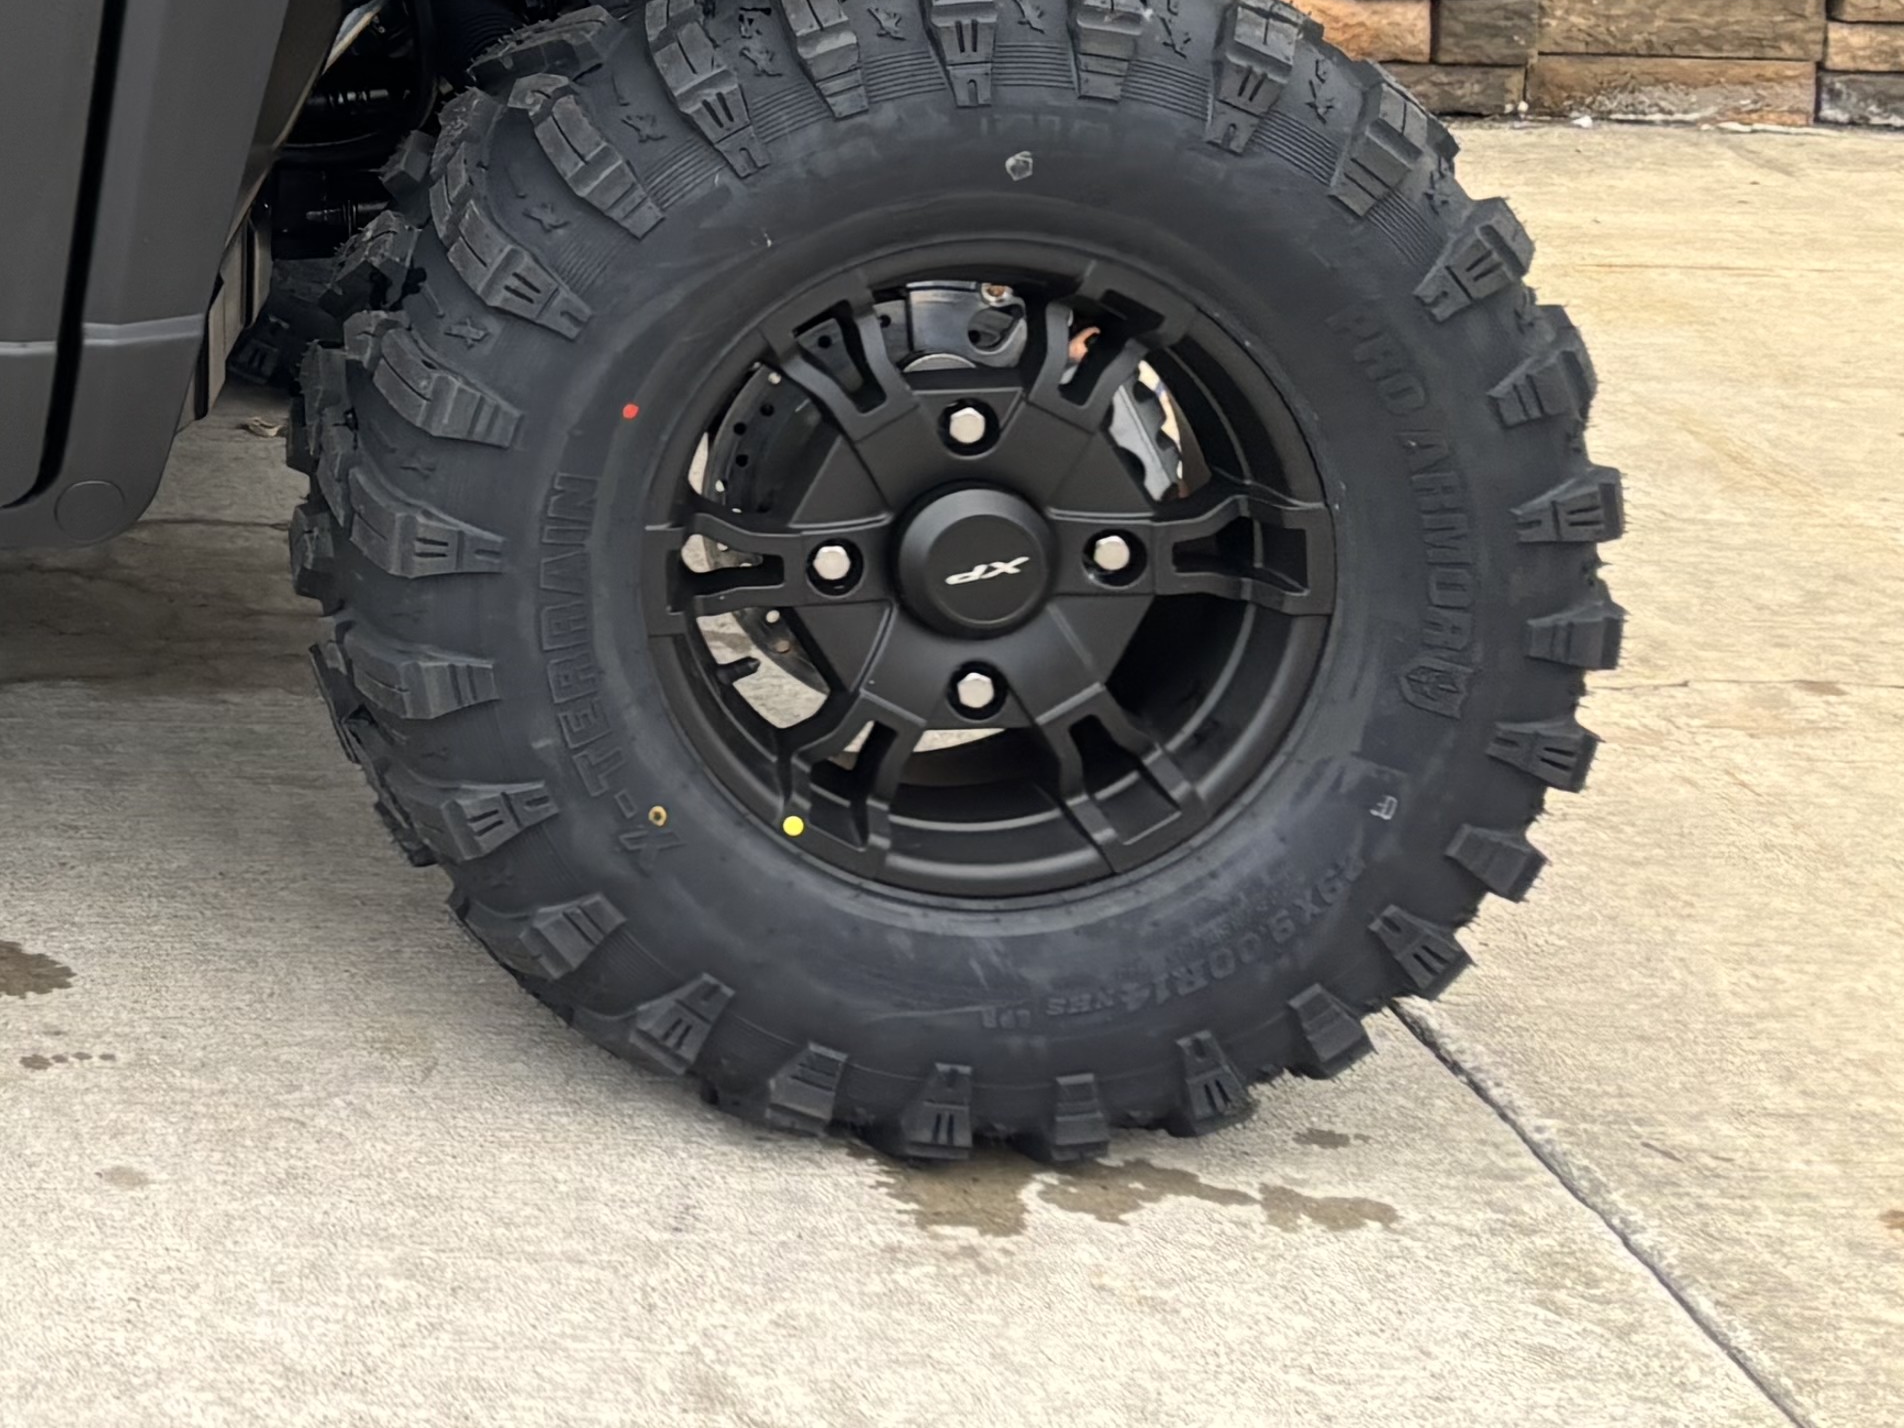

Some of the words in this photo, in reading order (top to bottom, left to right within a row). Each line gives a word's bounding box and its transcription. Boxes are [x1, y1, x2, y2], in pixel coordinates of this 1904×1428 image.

[944, 555, 1032, 586] XP
[1397, 429, 1476, 653] ARMOR
[540, 472, 681, 877] X-TERRAIN
